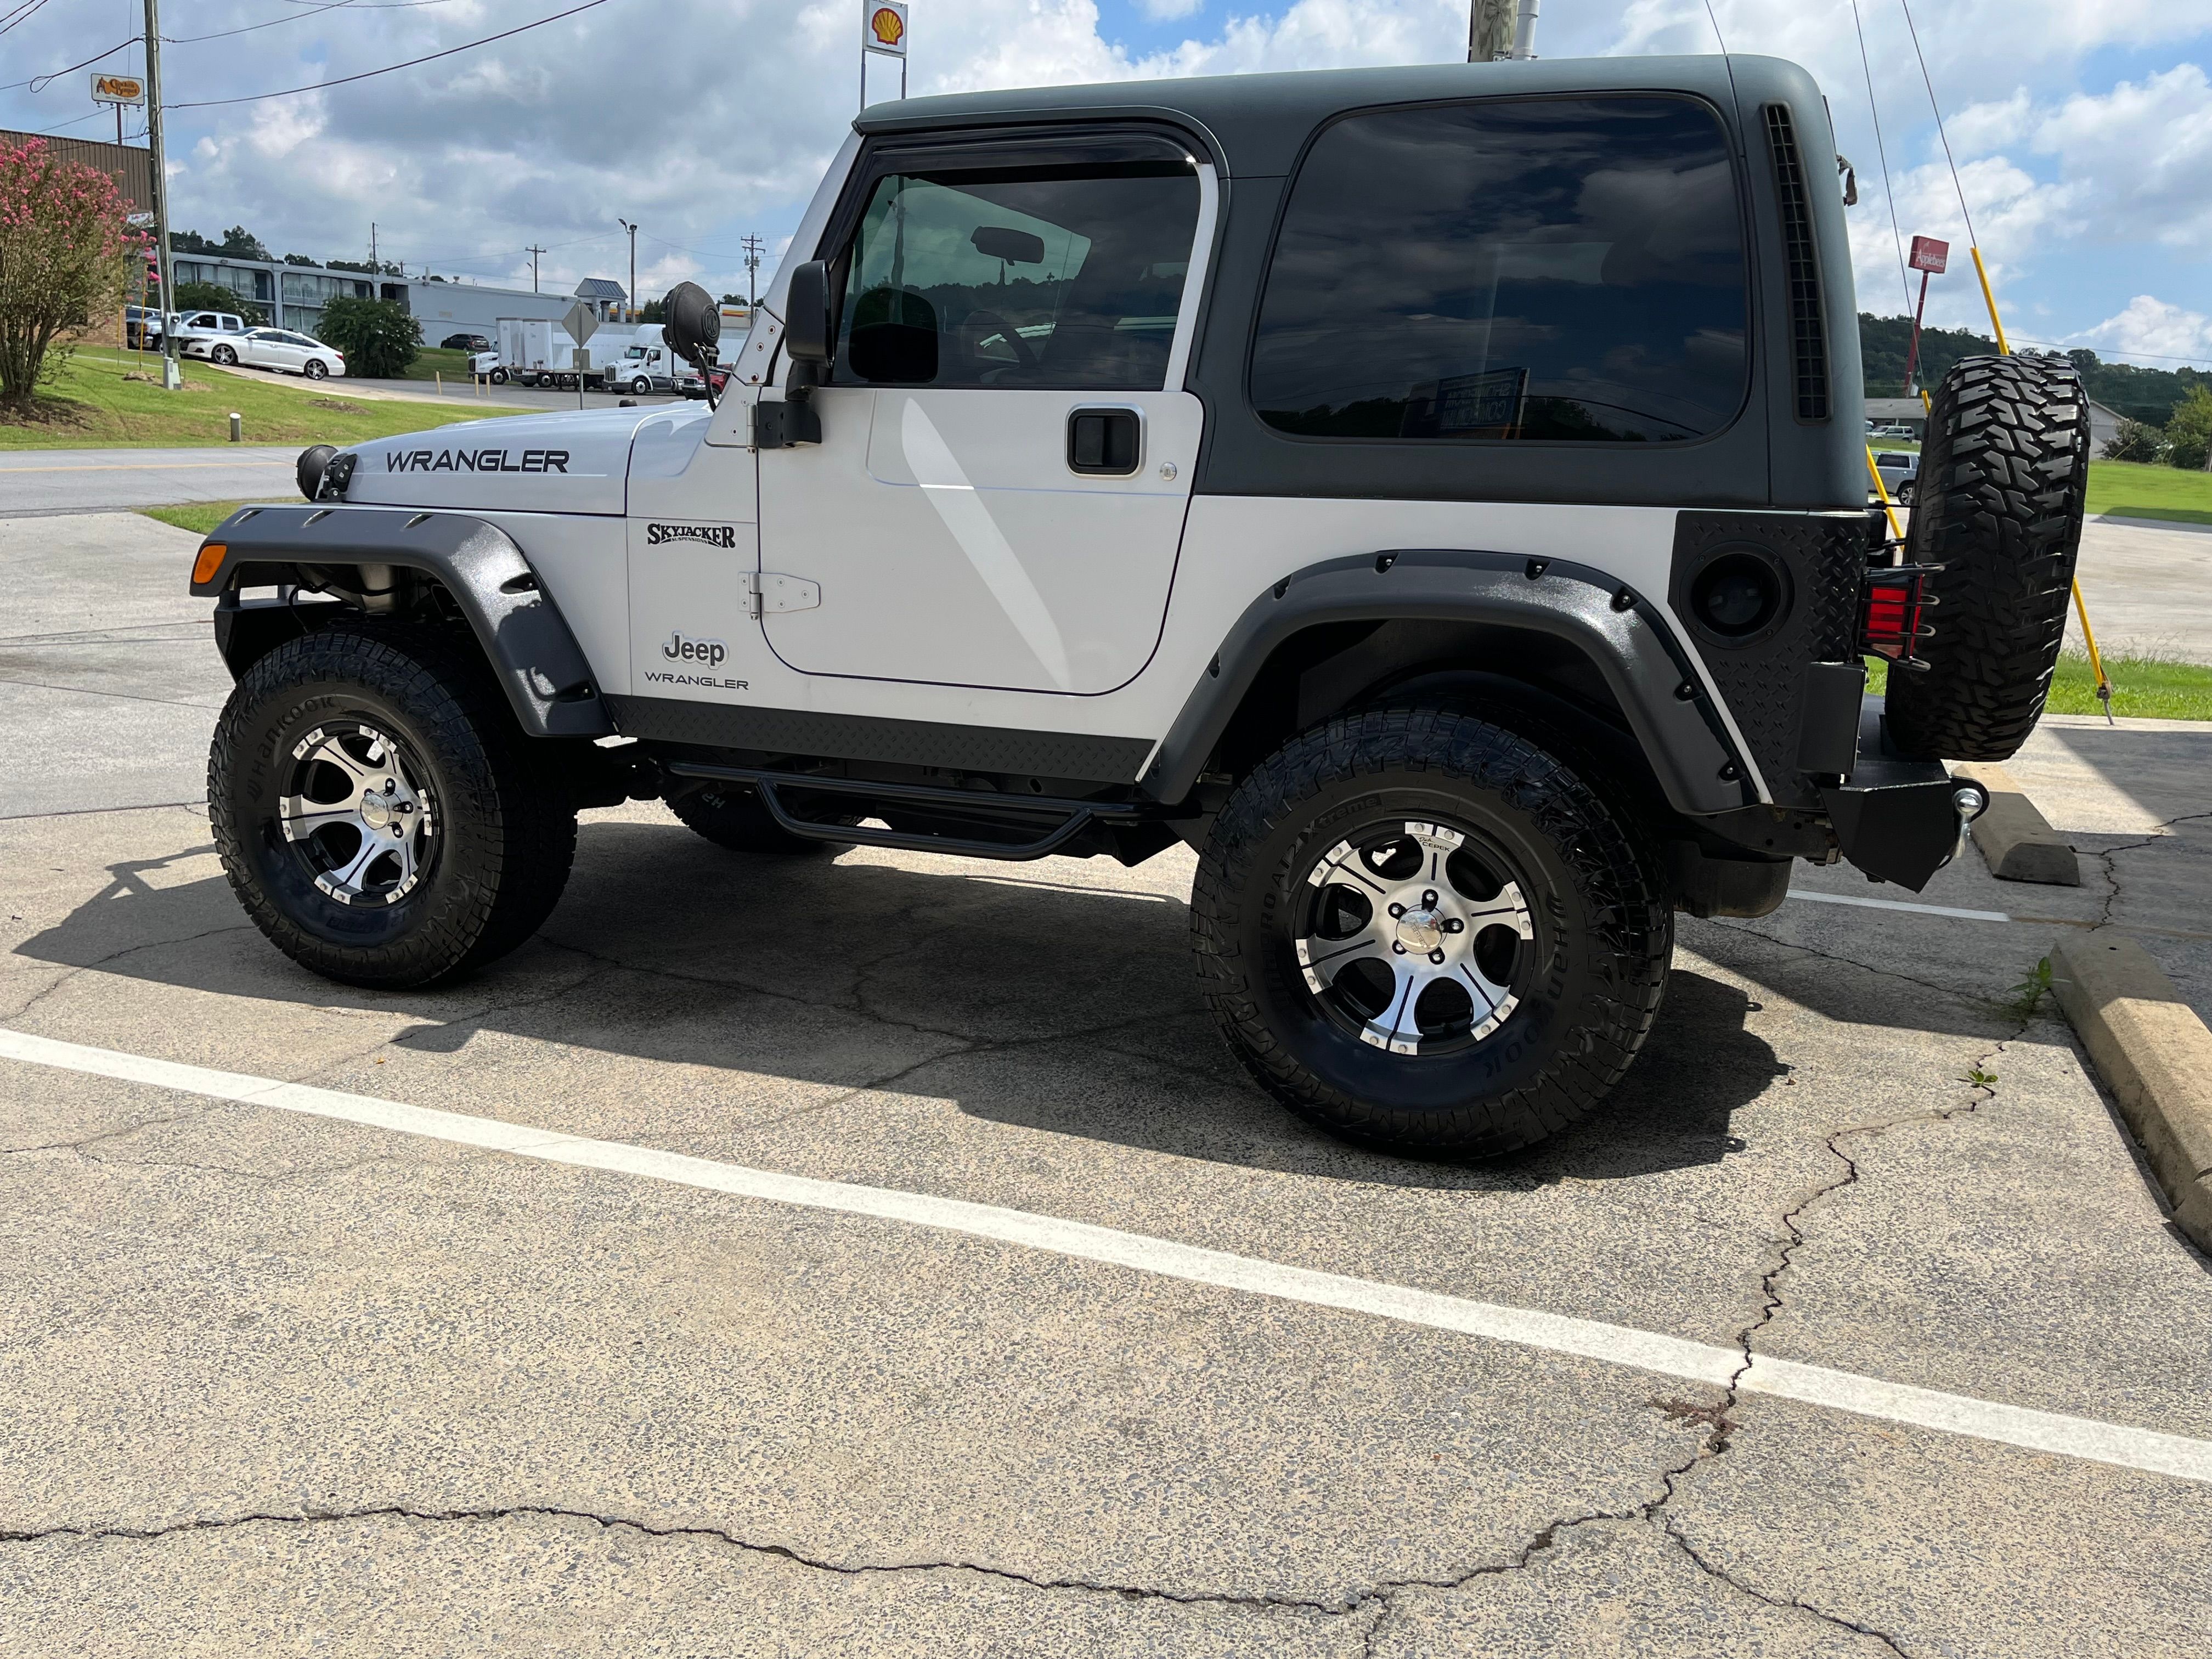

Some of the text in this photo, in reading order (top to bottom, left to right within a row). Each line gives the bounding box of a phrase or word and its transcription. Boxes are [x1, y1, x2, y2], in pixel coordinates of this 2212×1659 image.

[387, 449, 569, 473] WRANGLER
[647, 523, 736, 548] SKYJACKER
[664, 635, 724, 666] Jeep
[645, 672, 749, 690] WRANGLER
[1423, 842, 1450, 851] CEPEK
